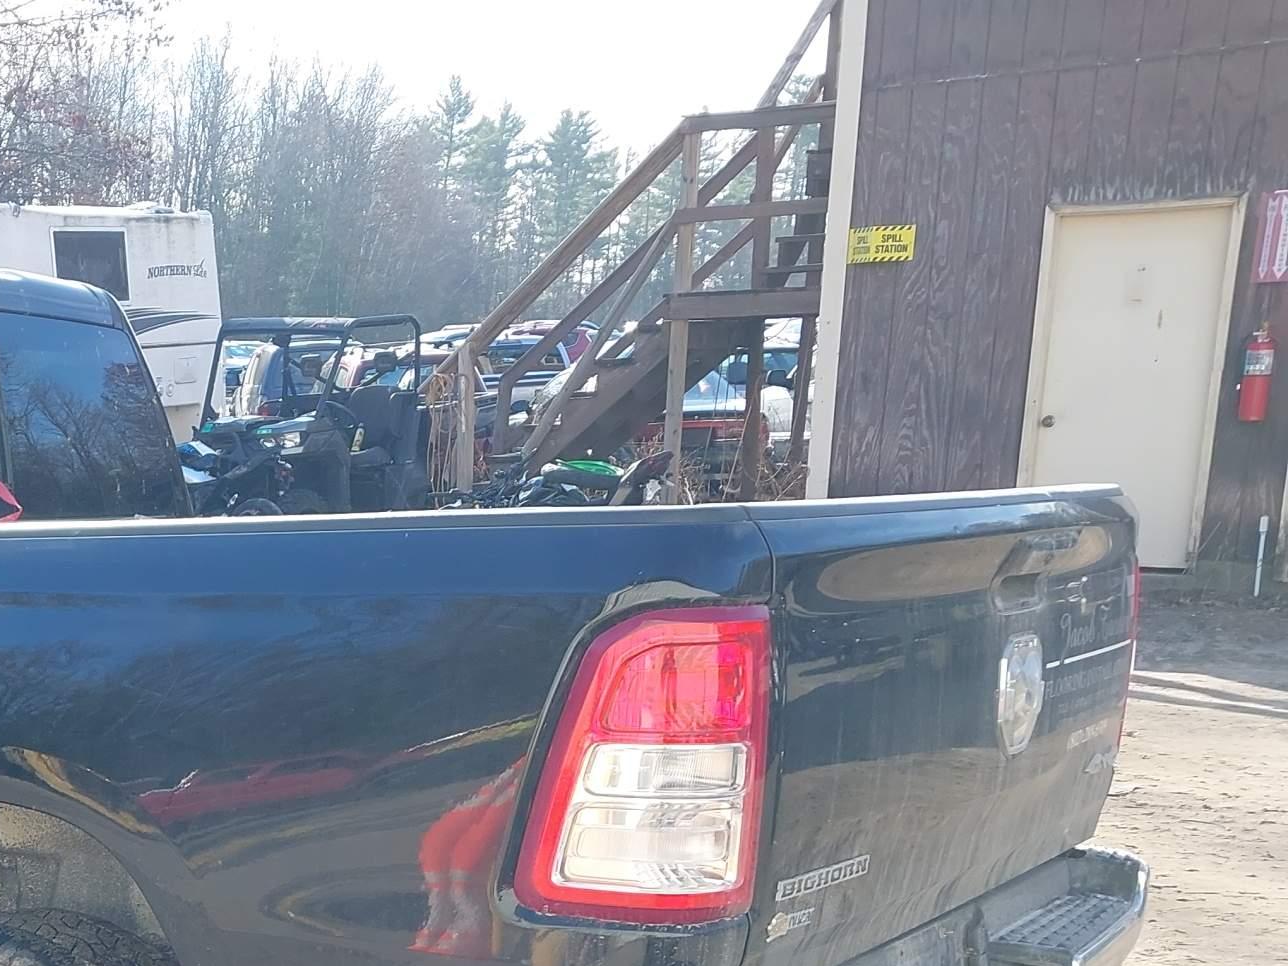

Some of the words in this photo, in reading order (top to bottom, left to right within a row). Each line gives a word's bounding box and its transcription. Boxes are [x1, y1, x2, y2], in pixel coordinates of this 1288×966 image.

[881, 233, 903, 243] SPILL
[874, 244, 908, 254] STATION
[146, 264, 192, 279] NORTHERN
[776, 854, 870, 901] BIGHORN
